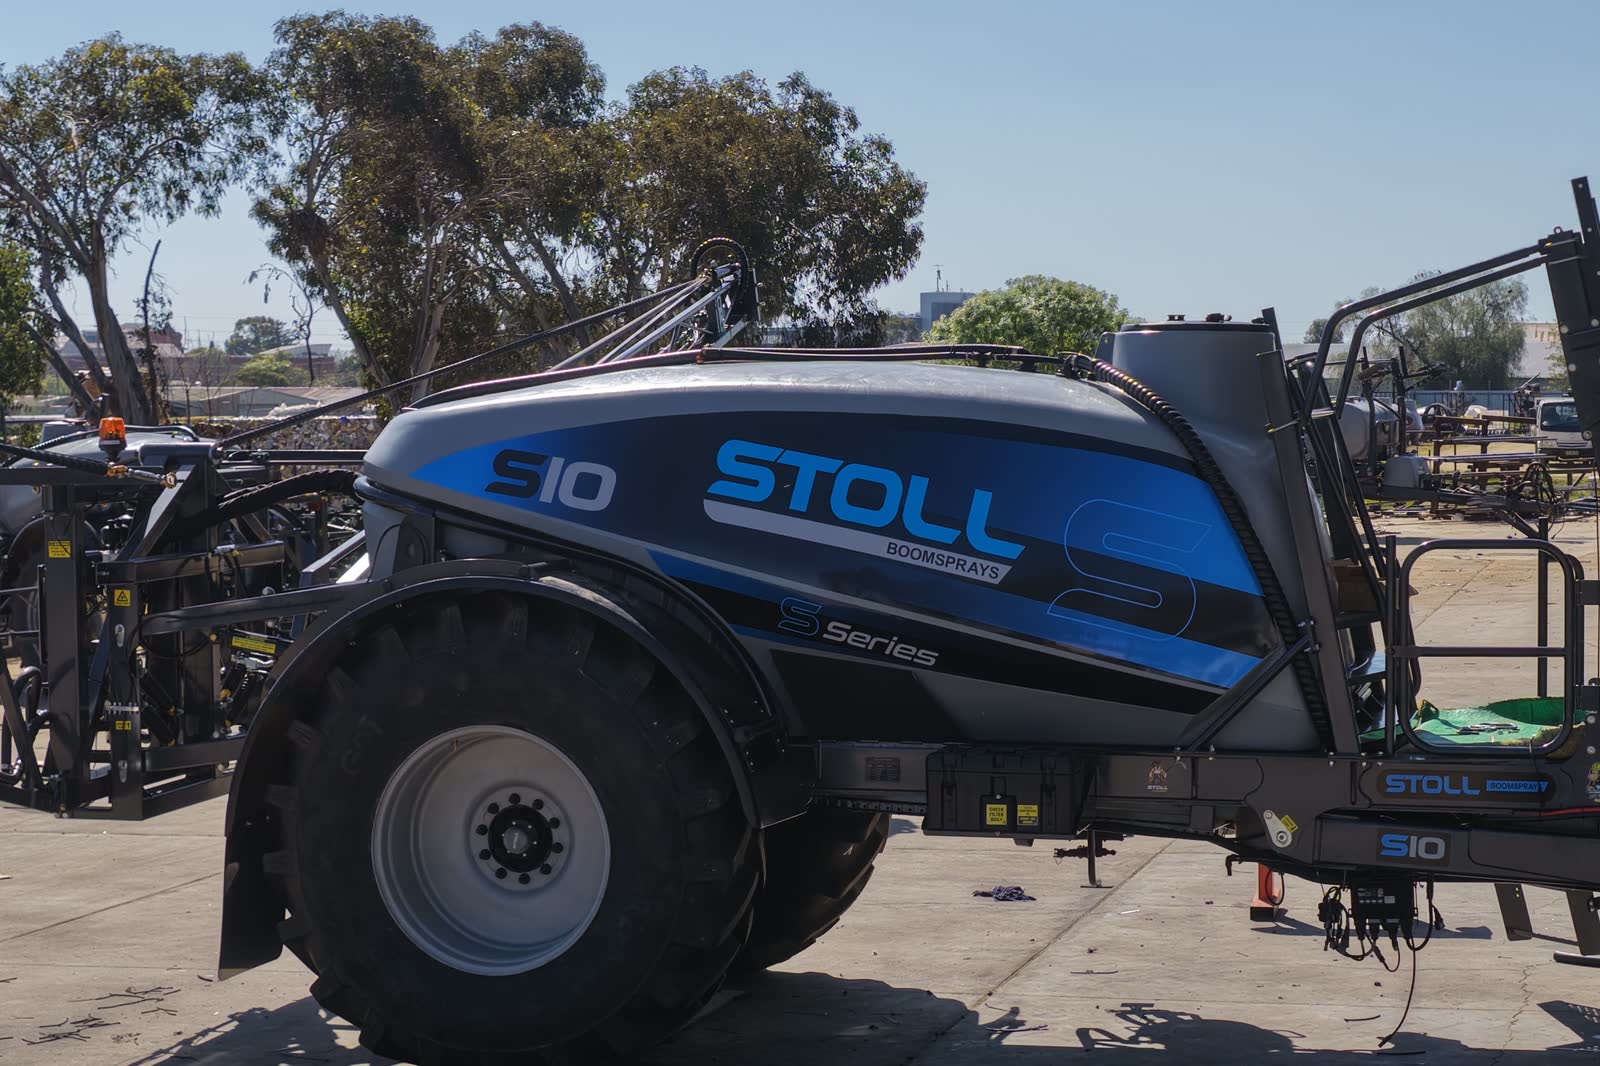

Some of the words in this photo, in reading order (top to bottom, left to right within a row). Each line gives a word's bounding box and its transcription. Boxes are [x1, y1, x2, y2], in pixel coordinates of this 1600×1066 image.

[484, 448, 617, 512] S10
[706, 438, 1027, 560] STOLL
[886, 540, 1002, 581] BOOMSPRAYS
[777, 596, 824, 637] S
[822, 620, 940, 667] Series
[1385, 773, 1481, 796] STOLL
[1490, 781, 1541, 791] BOOMSPRAY
[1380, 833, 1446, 860] S10
